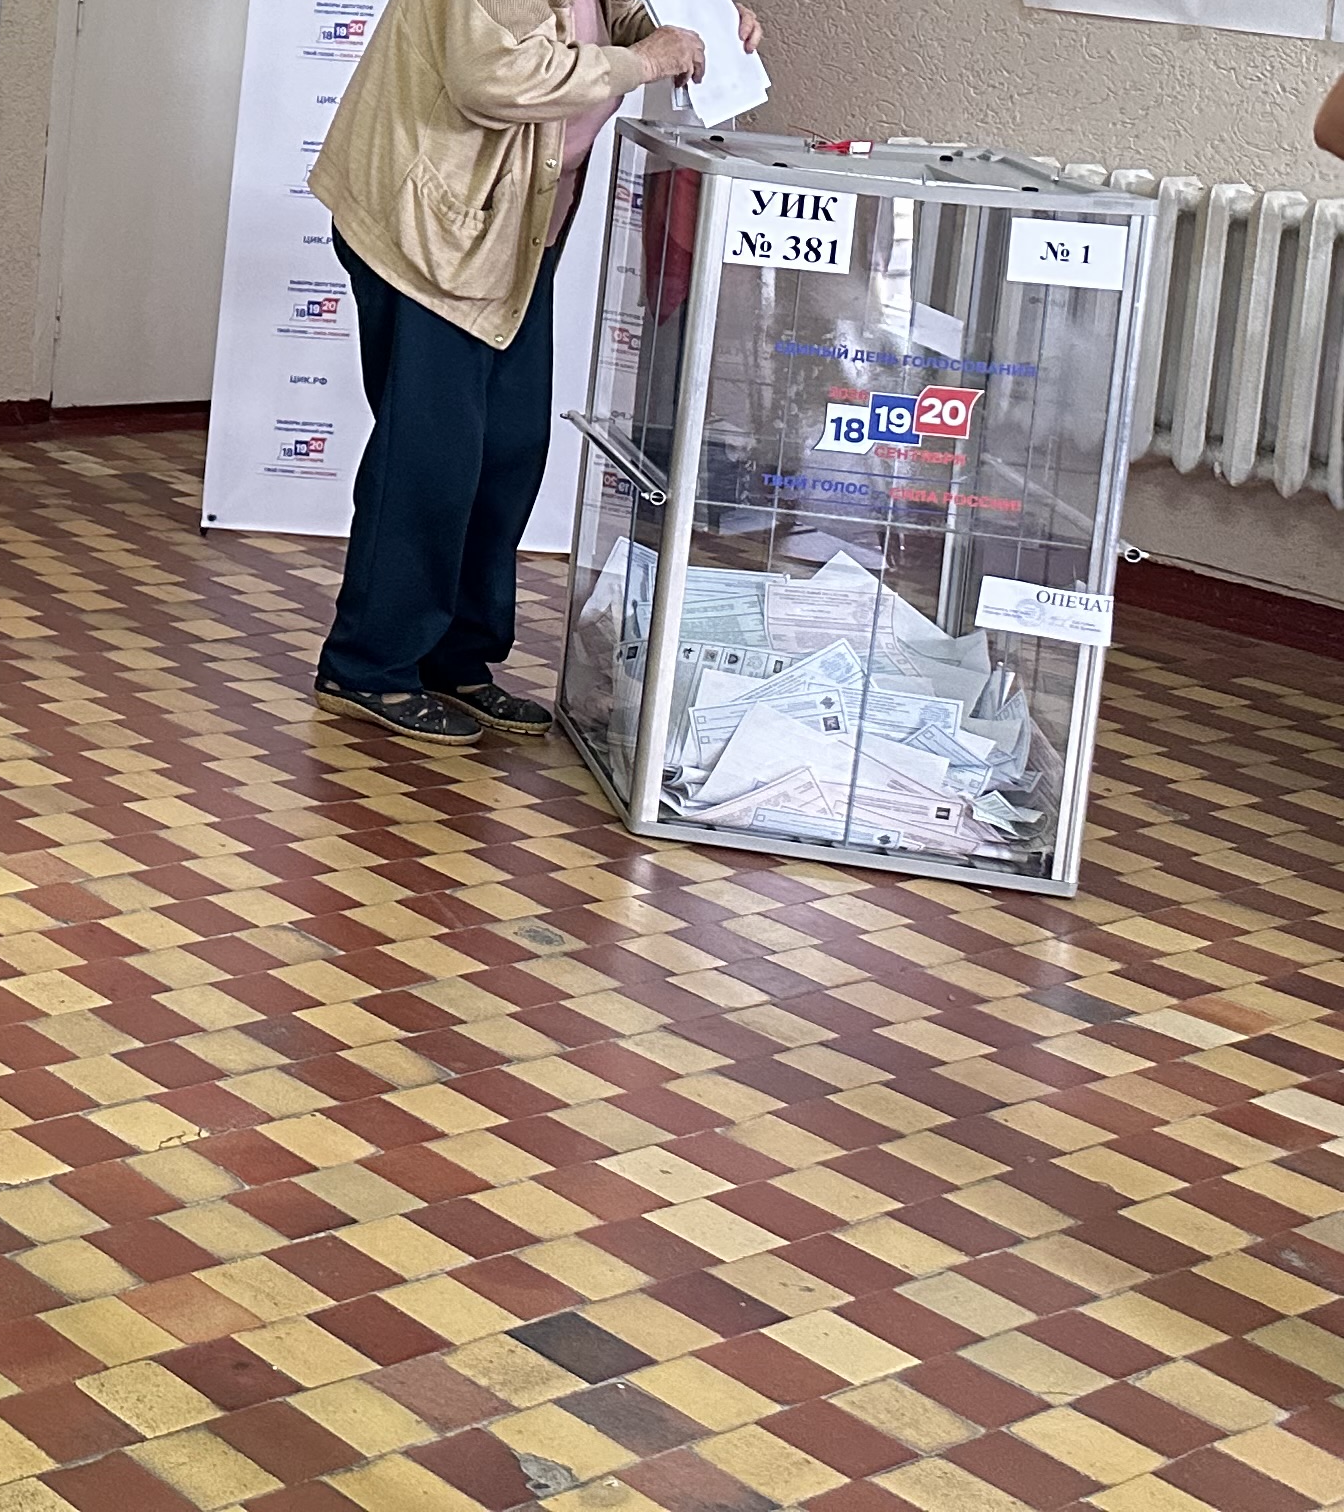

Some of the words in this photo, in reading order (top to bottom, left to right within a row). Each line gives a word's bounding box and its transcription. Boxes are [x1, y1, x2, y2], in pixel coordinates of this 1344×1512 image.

[335, 26, 347, 36] 19
[349, 23, 364, 33] 20
[321, 31, 333, 40] 18
[750, 189, 838, 222] УИК
[732, 230, 772, 259] №
[782, 235, 838, 265] 381
[1040, 241, 1070, 262] №
[1080, 245, 1091, 264] 1
[309, 304, 320, 314] 19
[322, 301, 337, 311] 20
[295, 308, 306, 318] 18
[774, 341, 849, 360] ЕДИНЫЙ
[852, 350, 899, 366] ДЕНЬ
[903, 354, 1037, 377] ГОЛОСОВАНИЯ
[289, 374, 328, 385] ЦИК.РФ
[919, 397, 967, 427] 20
[874, 405, 912, 434] 19
[830, 416, 865, 443] 18
[296, 443, 307, 453] 19
[309, 440, 323, 451] 20
[282, 447, 293, 457] 18
[874, 445, 967, 466] СЕНТЯБРЯ
[761, 473, 808, 490] ТВОЙ
[812, 479, 870, 496] ГОЛОС
[890, 488, 938, 504] СИЛА
